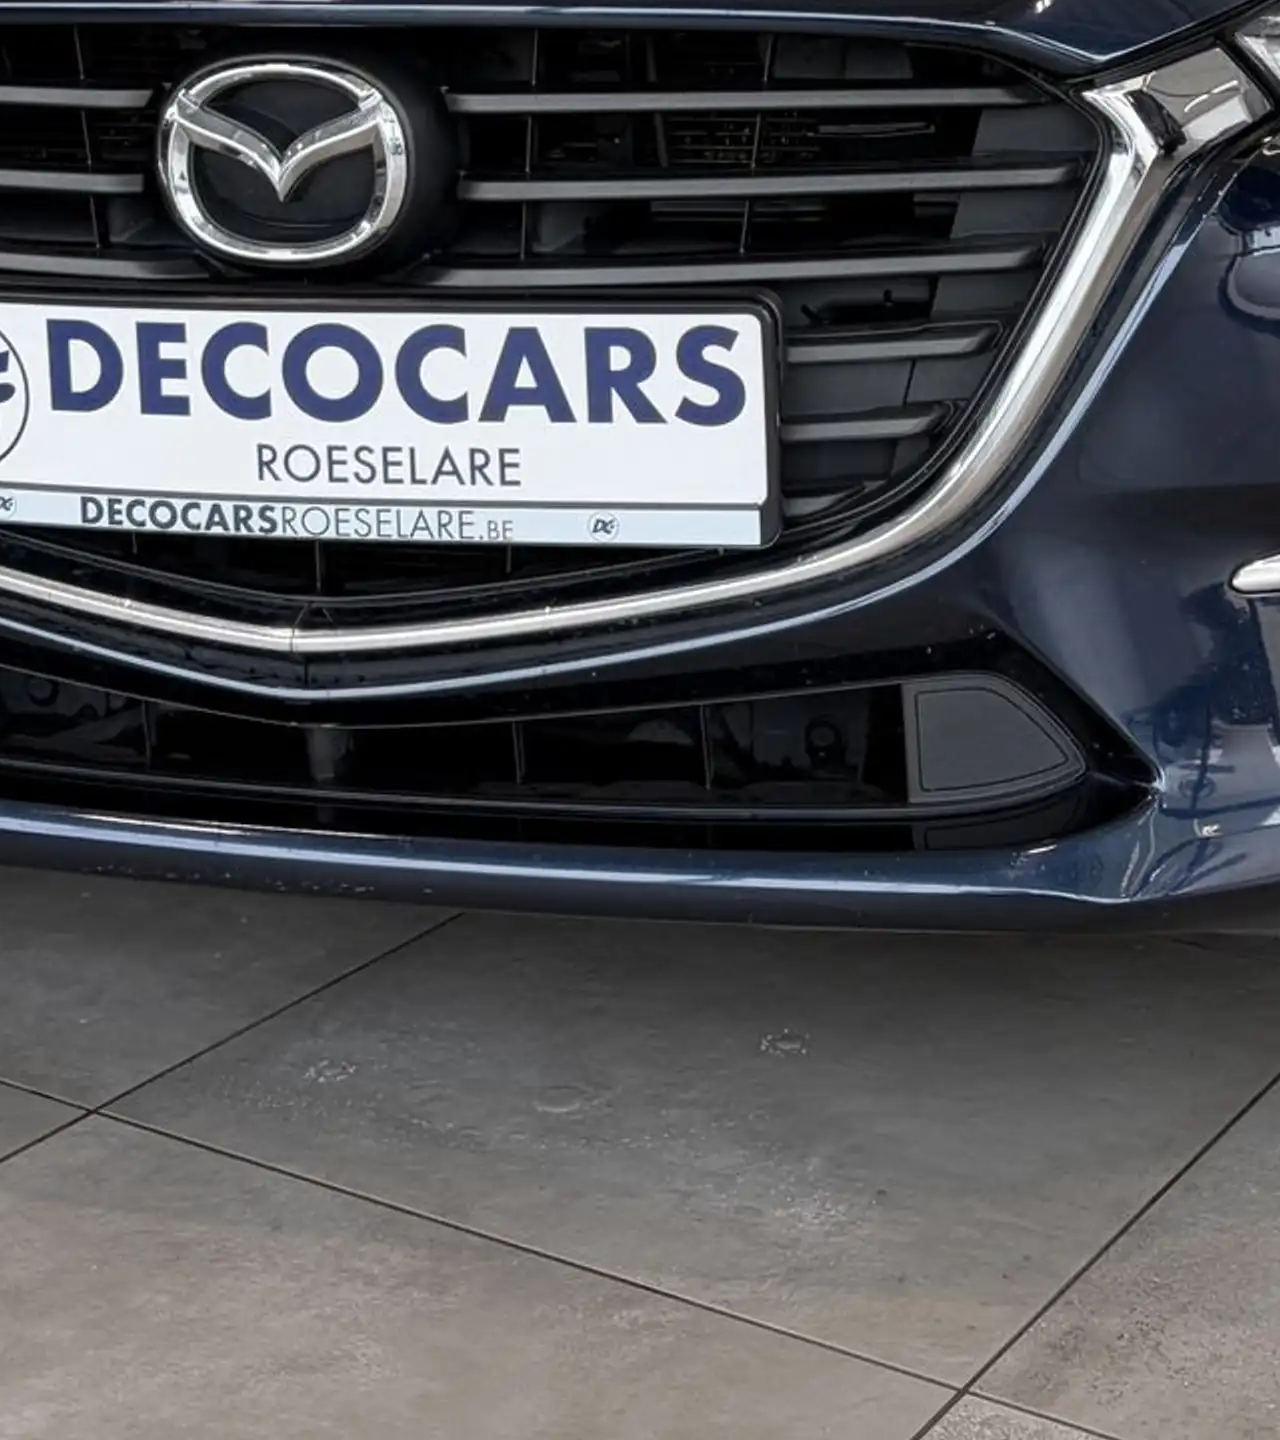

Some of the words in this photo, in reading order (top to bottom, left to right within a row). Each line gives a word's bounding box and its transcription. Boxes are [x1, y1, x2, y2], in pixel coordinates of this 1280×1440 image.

[45, 318, 747, 428] DECOCARS
[256, 443, 522, 488] ROESELARE
[79, 495, 515, 541] DECOCARSROESELARE.BE
